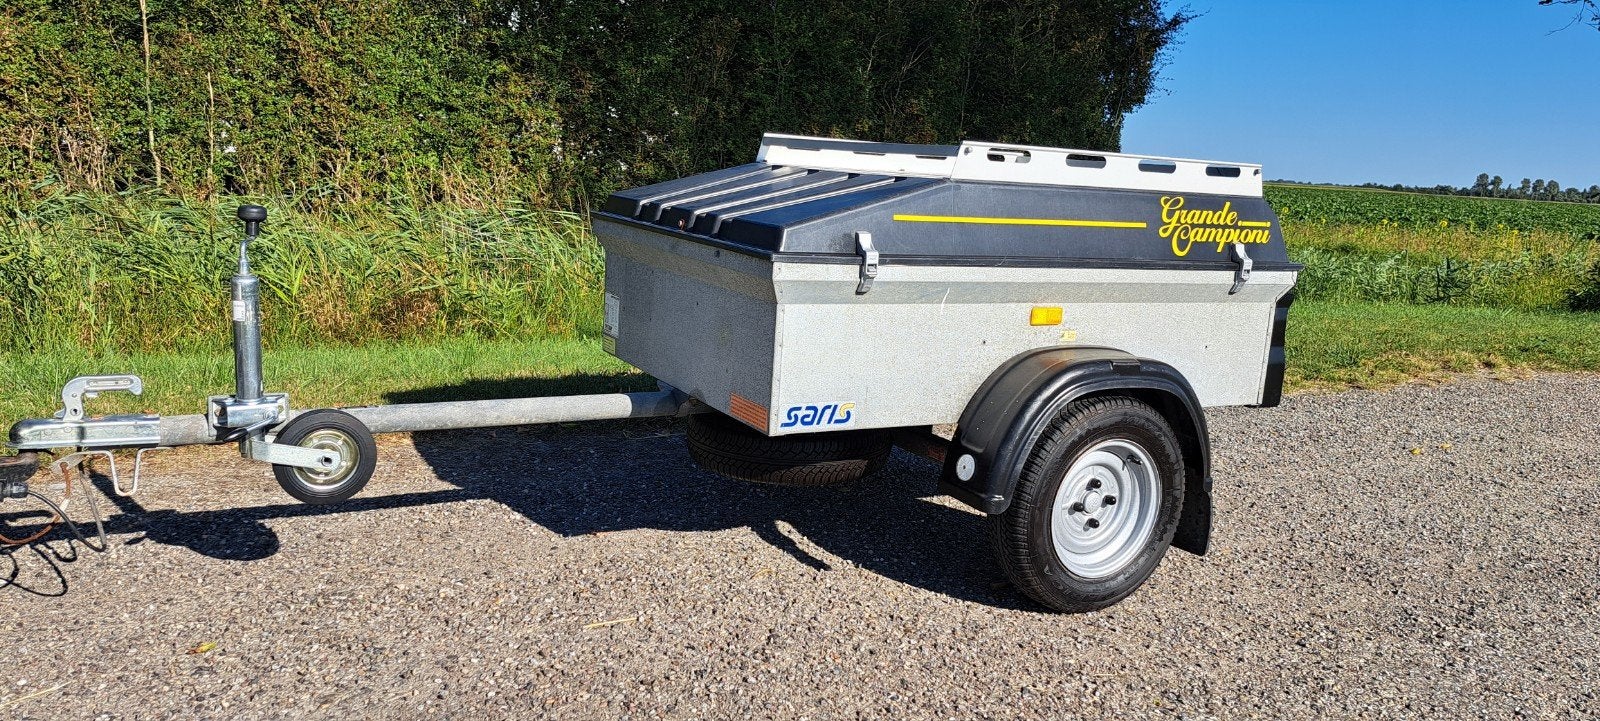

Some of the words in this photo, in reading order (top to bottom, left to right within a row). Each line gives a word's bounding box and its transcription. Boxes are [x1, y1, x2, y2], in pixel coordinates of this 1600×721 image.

[1158, 196, 1238, 238] Grande
[1172, 224, 1271, 257] Campioni
[780, 402, 855, 428] saris
